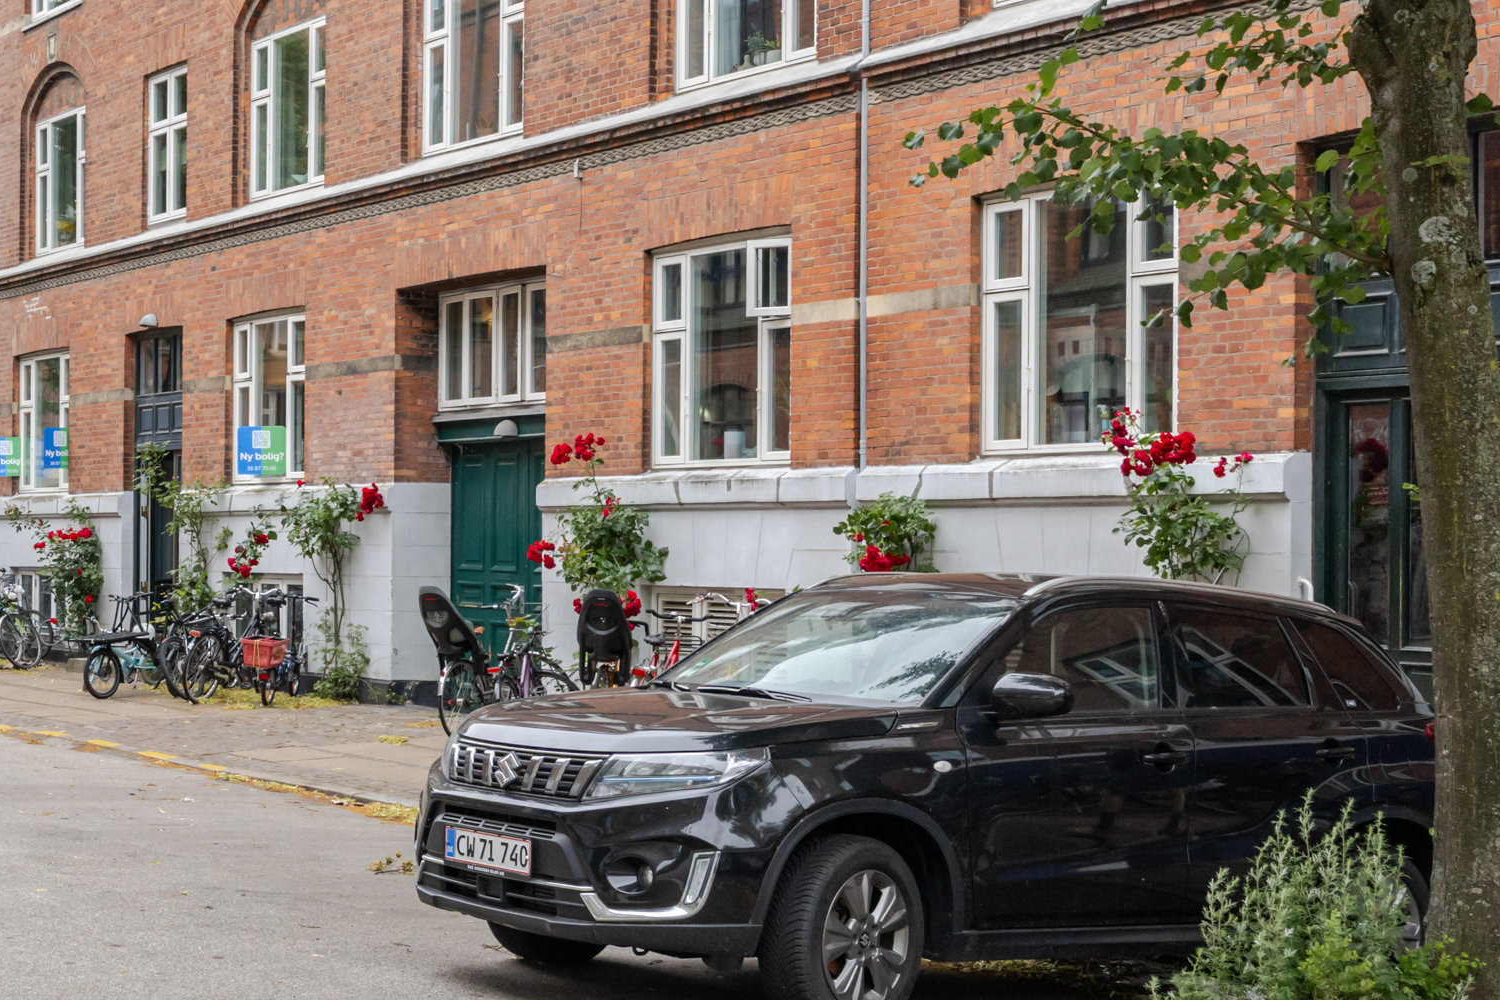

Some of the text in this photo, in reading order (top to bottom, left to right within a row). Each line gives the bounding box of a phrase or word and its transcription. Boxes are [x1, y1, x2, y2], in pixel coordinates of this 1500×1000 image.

[45, 449, 69, 458] Ny boli
[240, 452, 285, 462] Ny bolig?
[0, 458, 20, 466] bolig
[456, 835, 528, 868] CW 71 740
